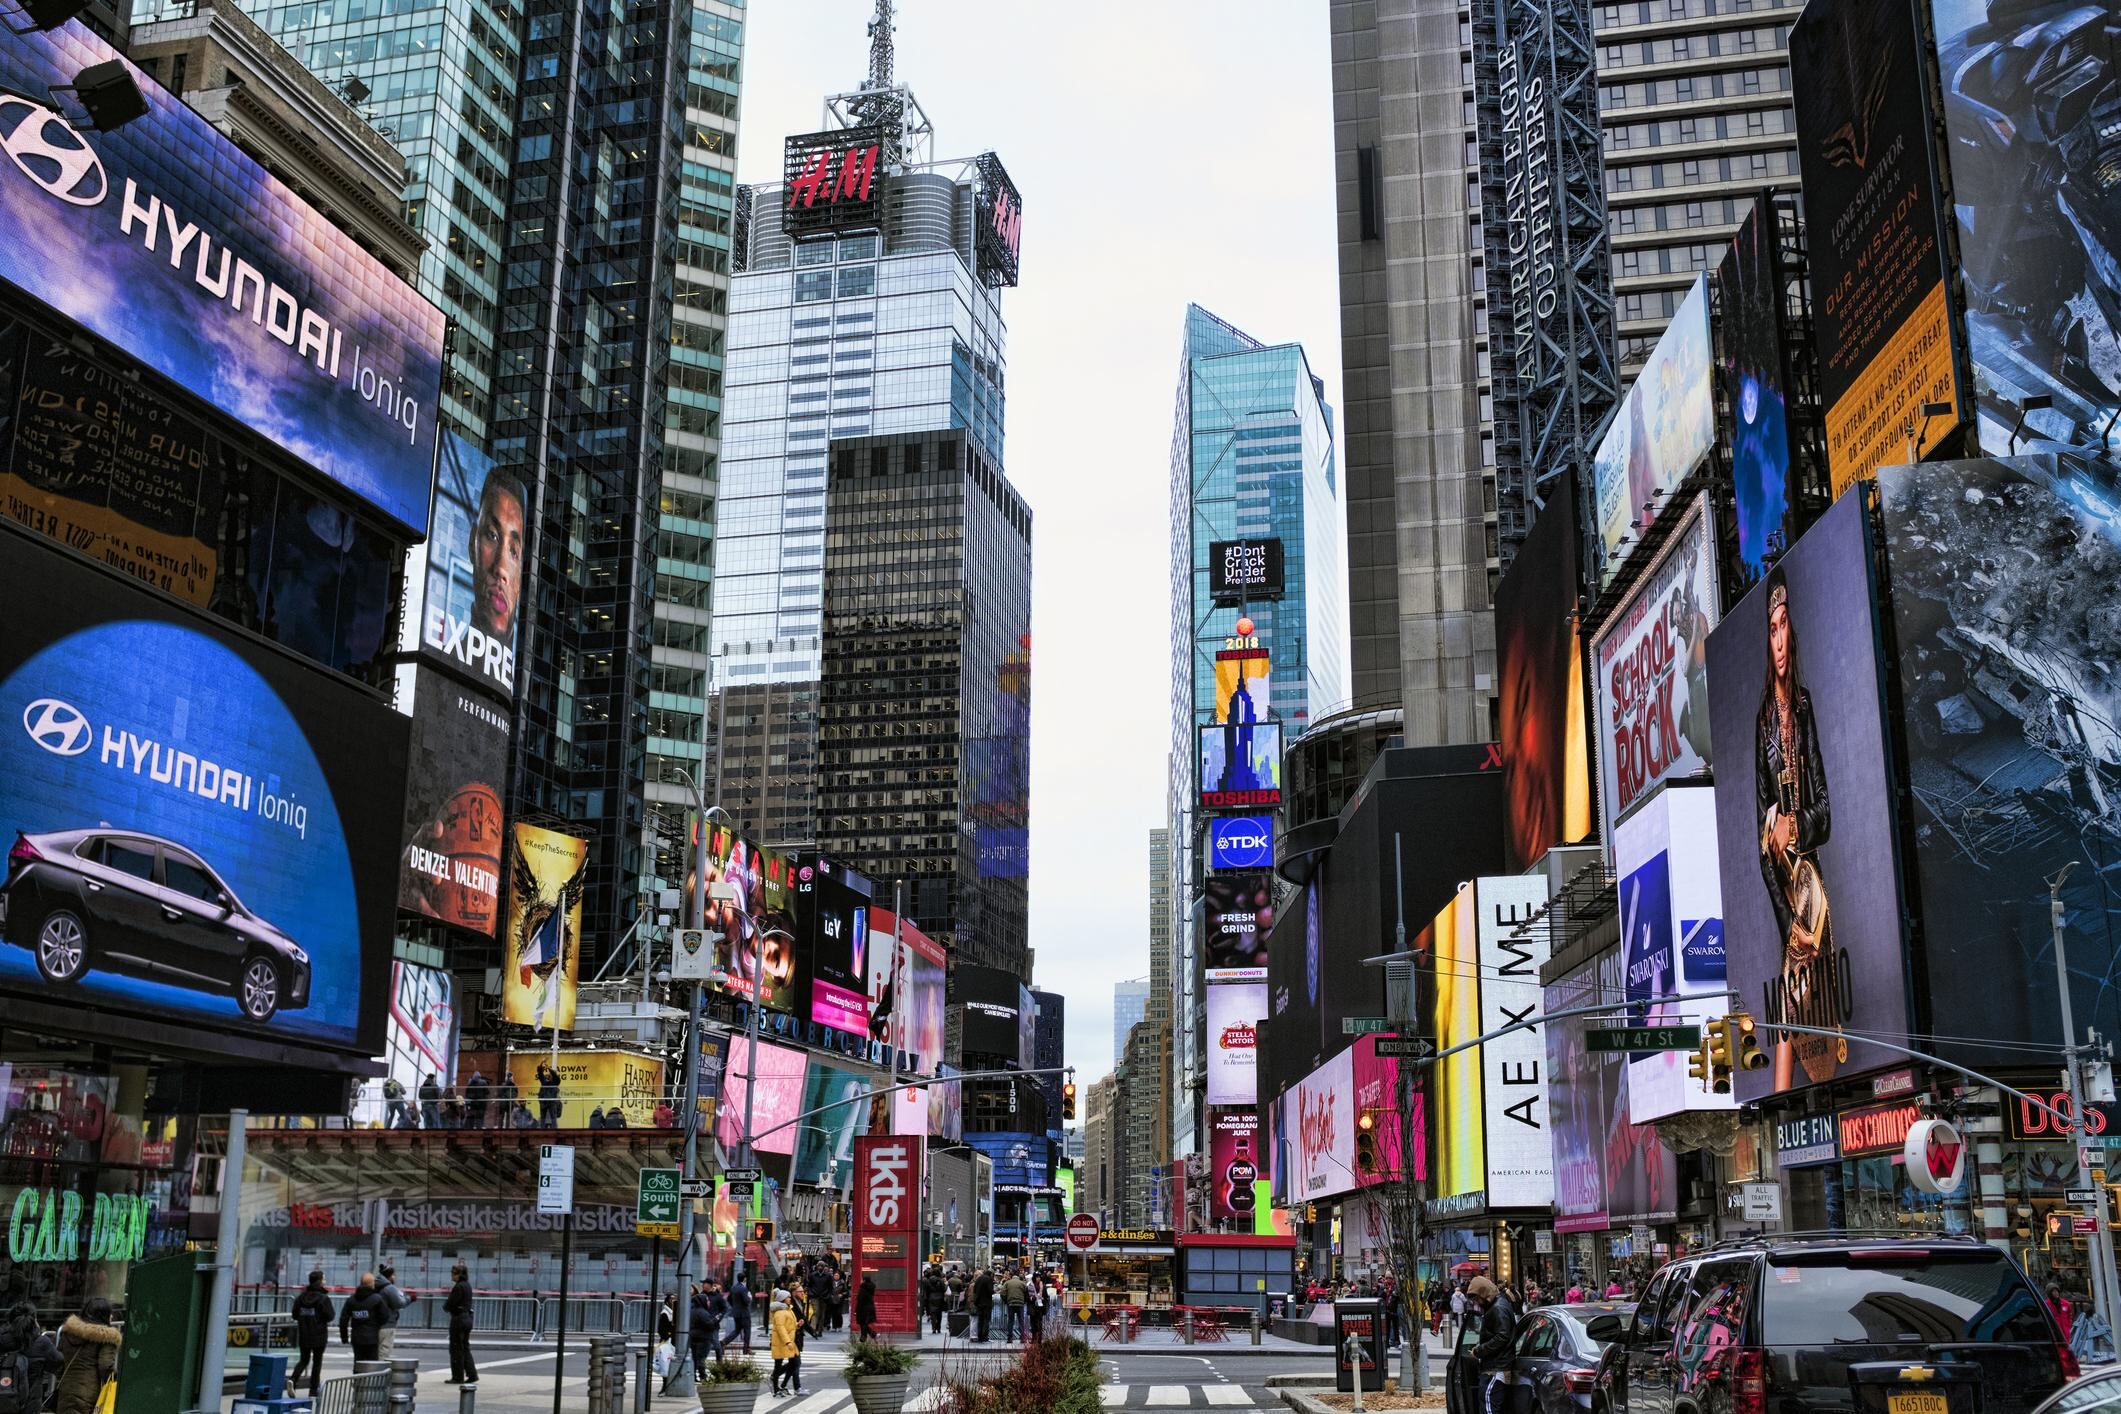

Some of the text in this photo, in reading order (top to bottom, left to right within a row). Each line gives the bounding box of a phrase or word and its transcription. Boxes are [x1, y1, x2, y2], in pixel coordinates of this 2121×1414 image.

[789, 144, 879, 209] H&M
[1523, 76, 1558, 319] OUTFITTERS
[1831, 134, 1904, 245] LONE SURVIVOR
[992, 184, 1021, 259] H&M
[1498, 41, 1536, 380] AMERICAN EAGLE
[1839, 169, 1901, 259] FOUNDATION
[1826, 183, 1919, 315] OUR MISSION
[1839, 234, 1918, 340] AND RENEW HOPE FOR
[120, 177, 419, 446] HYUNDAI Ioniq
[1828, 236, 1934, 369] WOUNDED SERVICE MEMBERS
[1845, 275, 1918, 369] AND THEIR FAMILIES
[1833, 319, 1942, 452] TO ATTEND A NO-COST RETREAT
[1848, 364, 1929, 464] OR SUPPORT LSF VISIT
[1225, 545, 1266, 557] #Dont
[1225, 555, 1266, 568] Crack
[1225, 566, 1266, 578] Under
[1225, 576, 1266, 585] Pressure
[1216, 650, 1269, 661] TOSHIBA
[1225, 637, 1259, 650] 2018
[1611, 601, 1676, 729] SCHOOL
[1614, 671, 1682, 812] ROCK
[100, 724, 308, 840] HYUNDAI Ioniq
[1202, 790, 1281, 806] TOSHIBA
[524, 838, 580, 859] #KeepTheSecrets
[1228, 835, 1268, 849] TDK
[410, 844, 452, 882] DENZEL
[823, 863, 830, 873] LG
[800, 884, 812, 892] LG
[825, 920, 834, 936] LG
[1220, 913, 1256, 923] FRESH
[1221, 923, 1256, 934] GRIND
[1495, 902, 1534, 977] ME
[1687, 946, 1726, 956] SWAROV
[1630, 947, 1669, 987] SWAROVSKI
[1763, 947, 1853, 1047] MOSCHINO
[1355, 1020, 1383, 1031] W 47
[1499, 1003, 1536, 1034] X
[1227, 1037, 1255, 1045] ARTOIS
[1410, 1043, 1428, 1052] WAY
[1612, 1031, 1674, 1047] W 47 St
[624, 1063, 658, 1088] HARRY
[620, 1086, 657, 1109] POTTER
[1009, 1080, 1017, 1113] 1500
[1503, 1060, 1541, 1130] AE
[2021, 1093, 2107, 1134] DOS
[1778, 1115, 1832, 1149] BLUE FIN
[1842, 1106, 1917, 1151] DOS CAMINOS
[544, 1147, 550, 1157] 1
[1779, 1146, 1834, 1163] SEAFOOD SUSHI
[1926, 1142, 1961, 1178] W
[541, 1177, 549, 1187] 6
[690, 1185, 707, 1193] WAY
[869, 1143, 909, 1227] tkts
[642, 1192, 677, 1202] South
[1118, 1229, 1155, 1240] dinges
[1343, 1320, 1372, 1328] SURE
[1343, 1328, 1372, 1336] THING
[1893, 1397, 1943, 1412] T665180C
